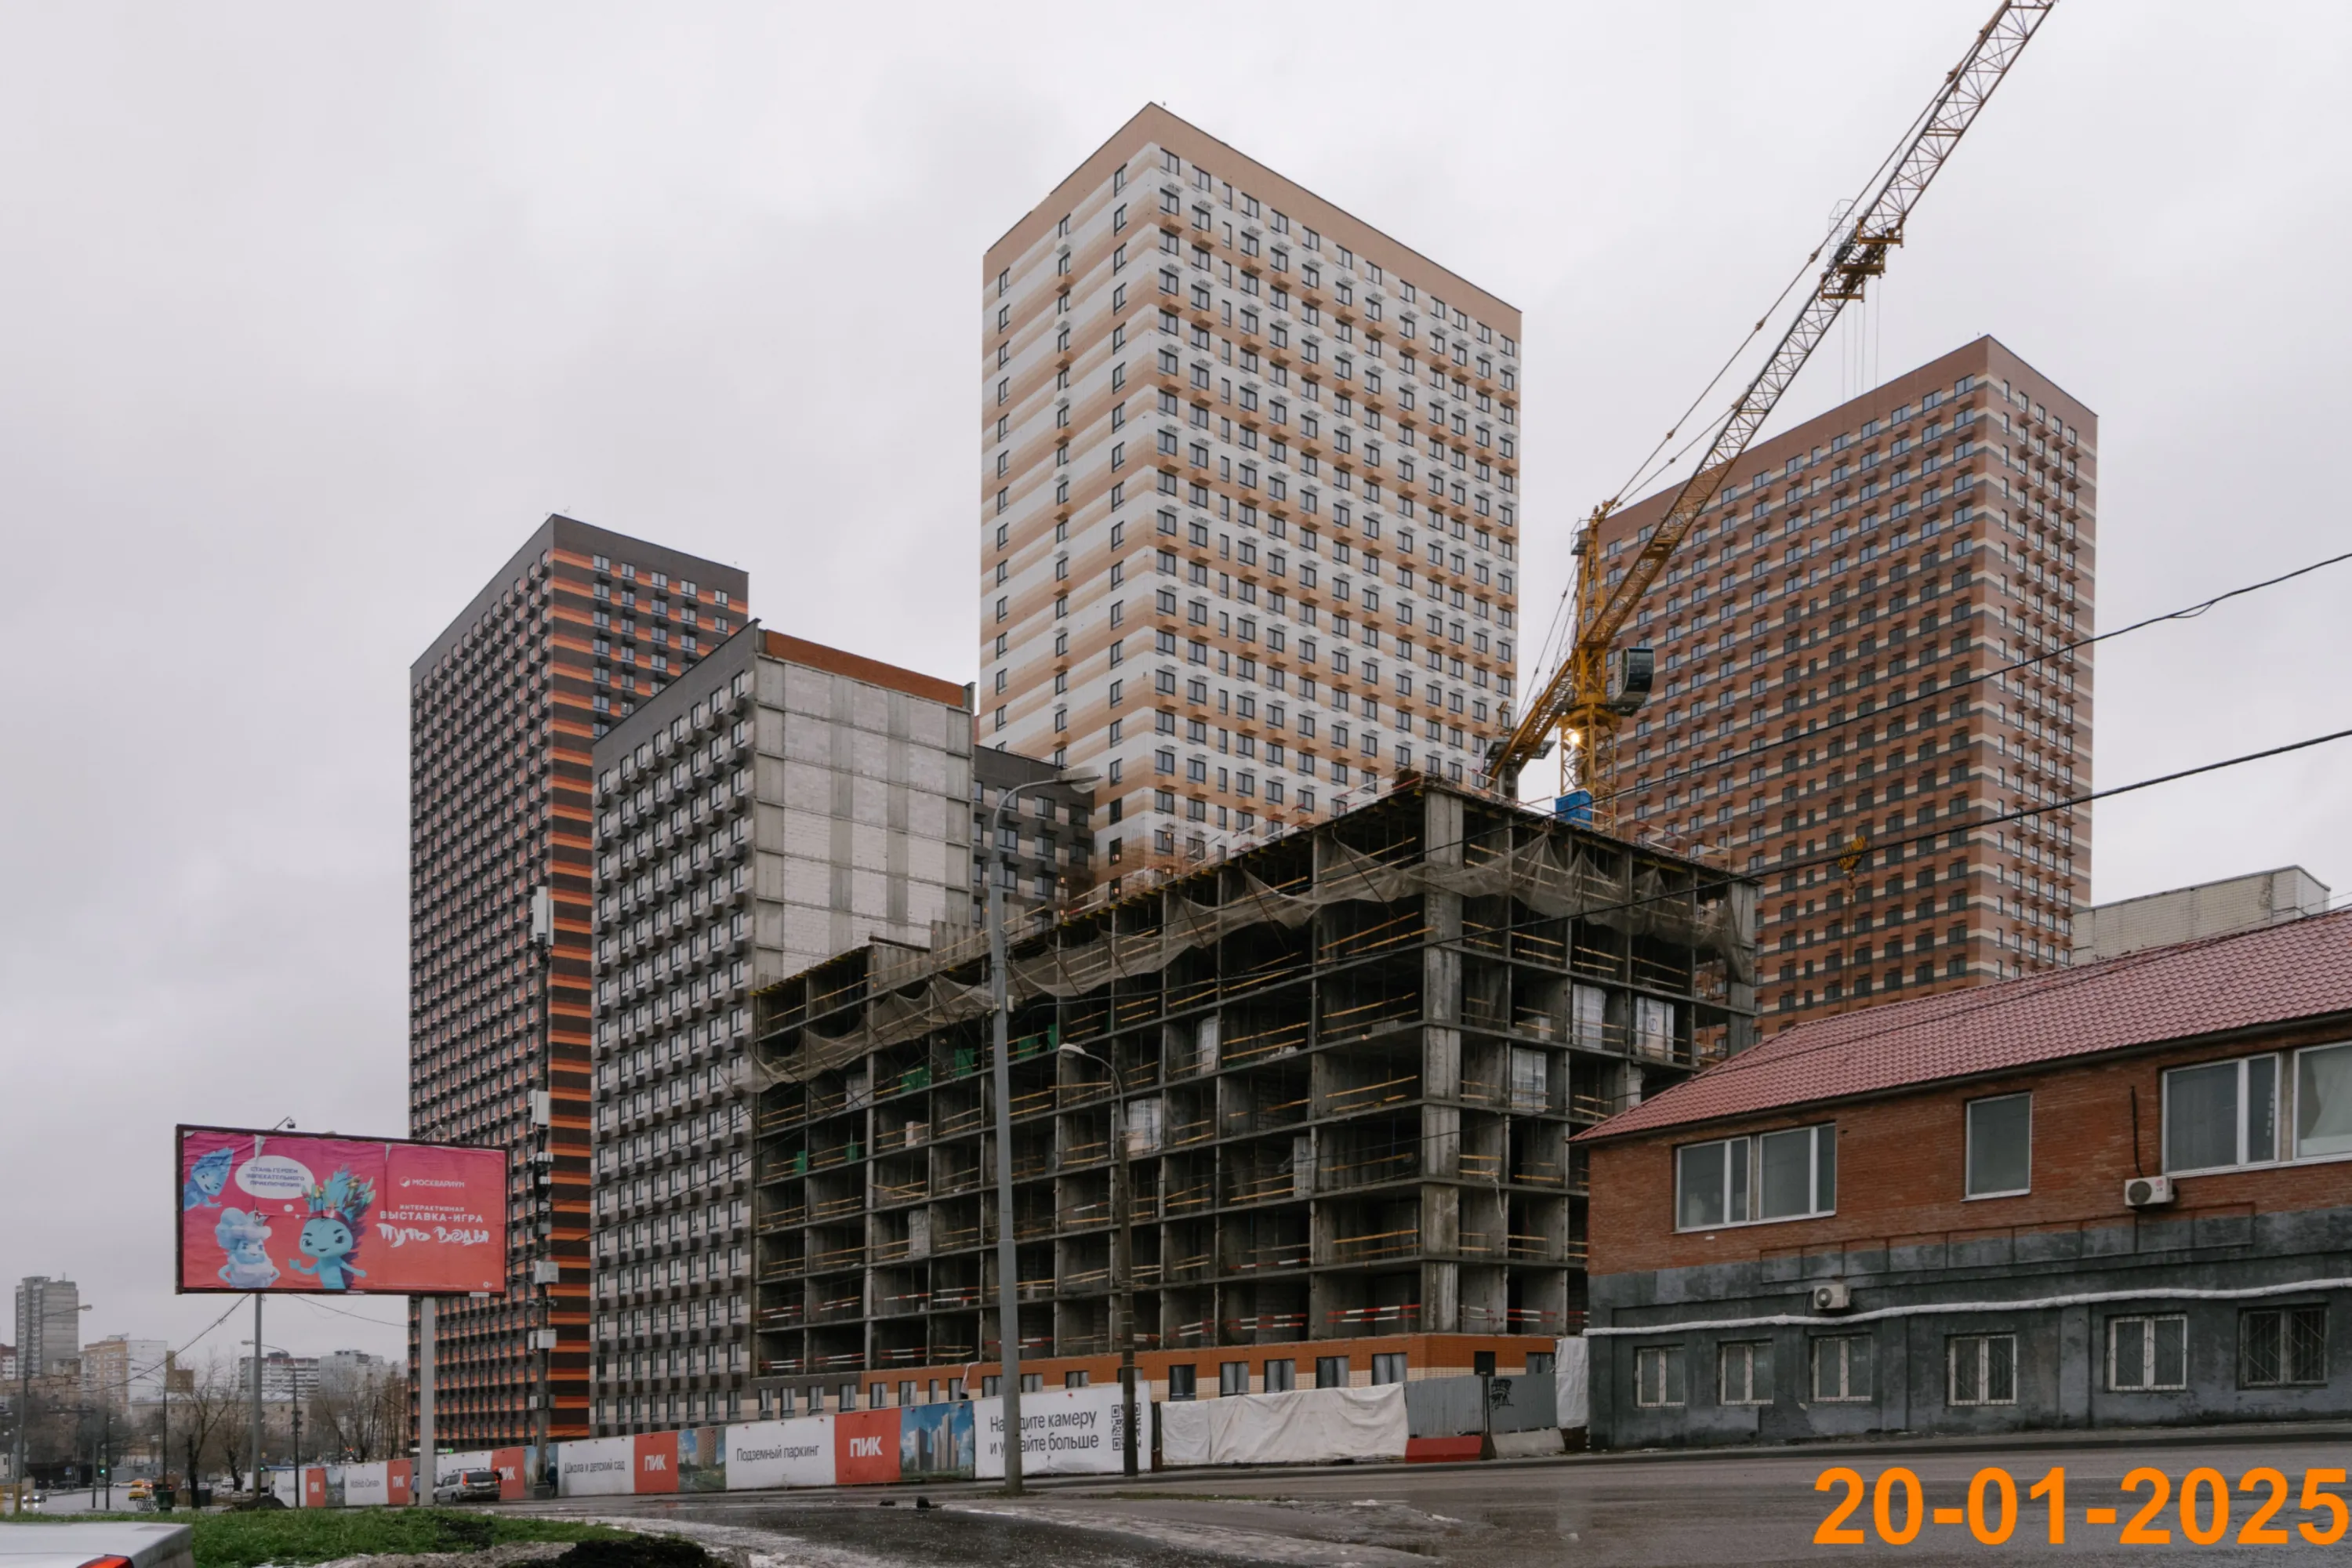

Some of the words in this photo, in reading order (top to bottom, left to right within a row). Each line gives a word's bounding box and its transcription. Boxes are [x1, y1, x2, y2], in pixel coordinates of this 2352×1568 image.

[412, 1178, 465, 1189] МОСКВАРИУМ
[399, 1203, 465, 1212] ИНТЕРАКТИВНАЯ
[379, 1210, 483, 1223] ВЫСТАВКА-ИГРА
[989, 1415, 1046, 1433] Надите
[1048, 1410, 1097, 1429] камеру
[736, 1444, 782, 1463] Подземный
[783, 1445, 820, 1461] паркинг
[849, 1436, 884, 1457] ПИК
[989, 1442, 997, 1455] и
[999, 1435, 1047, 1458] уайте
[1048, 1432, 1099, 1450] больше
[564, 1461, 584, 1474] Школа
[585, 1463, 589, 1472] и
[590, 1458, 613, 1473] детский
[614, 1460, 626, 1472] сад
[644, 1454, 667, 1472] ПИК
[393, 1475, 405, 1488] ПИК
